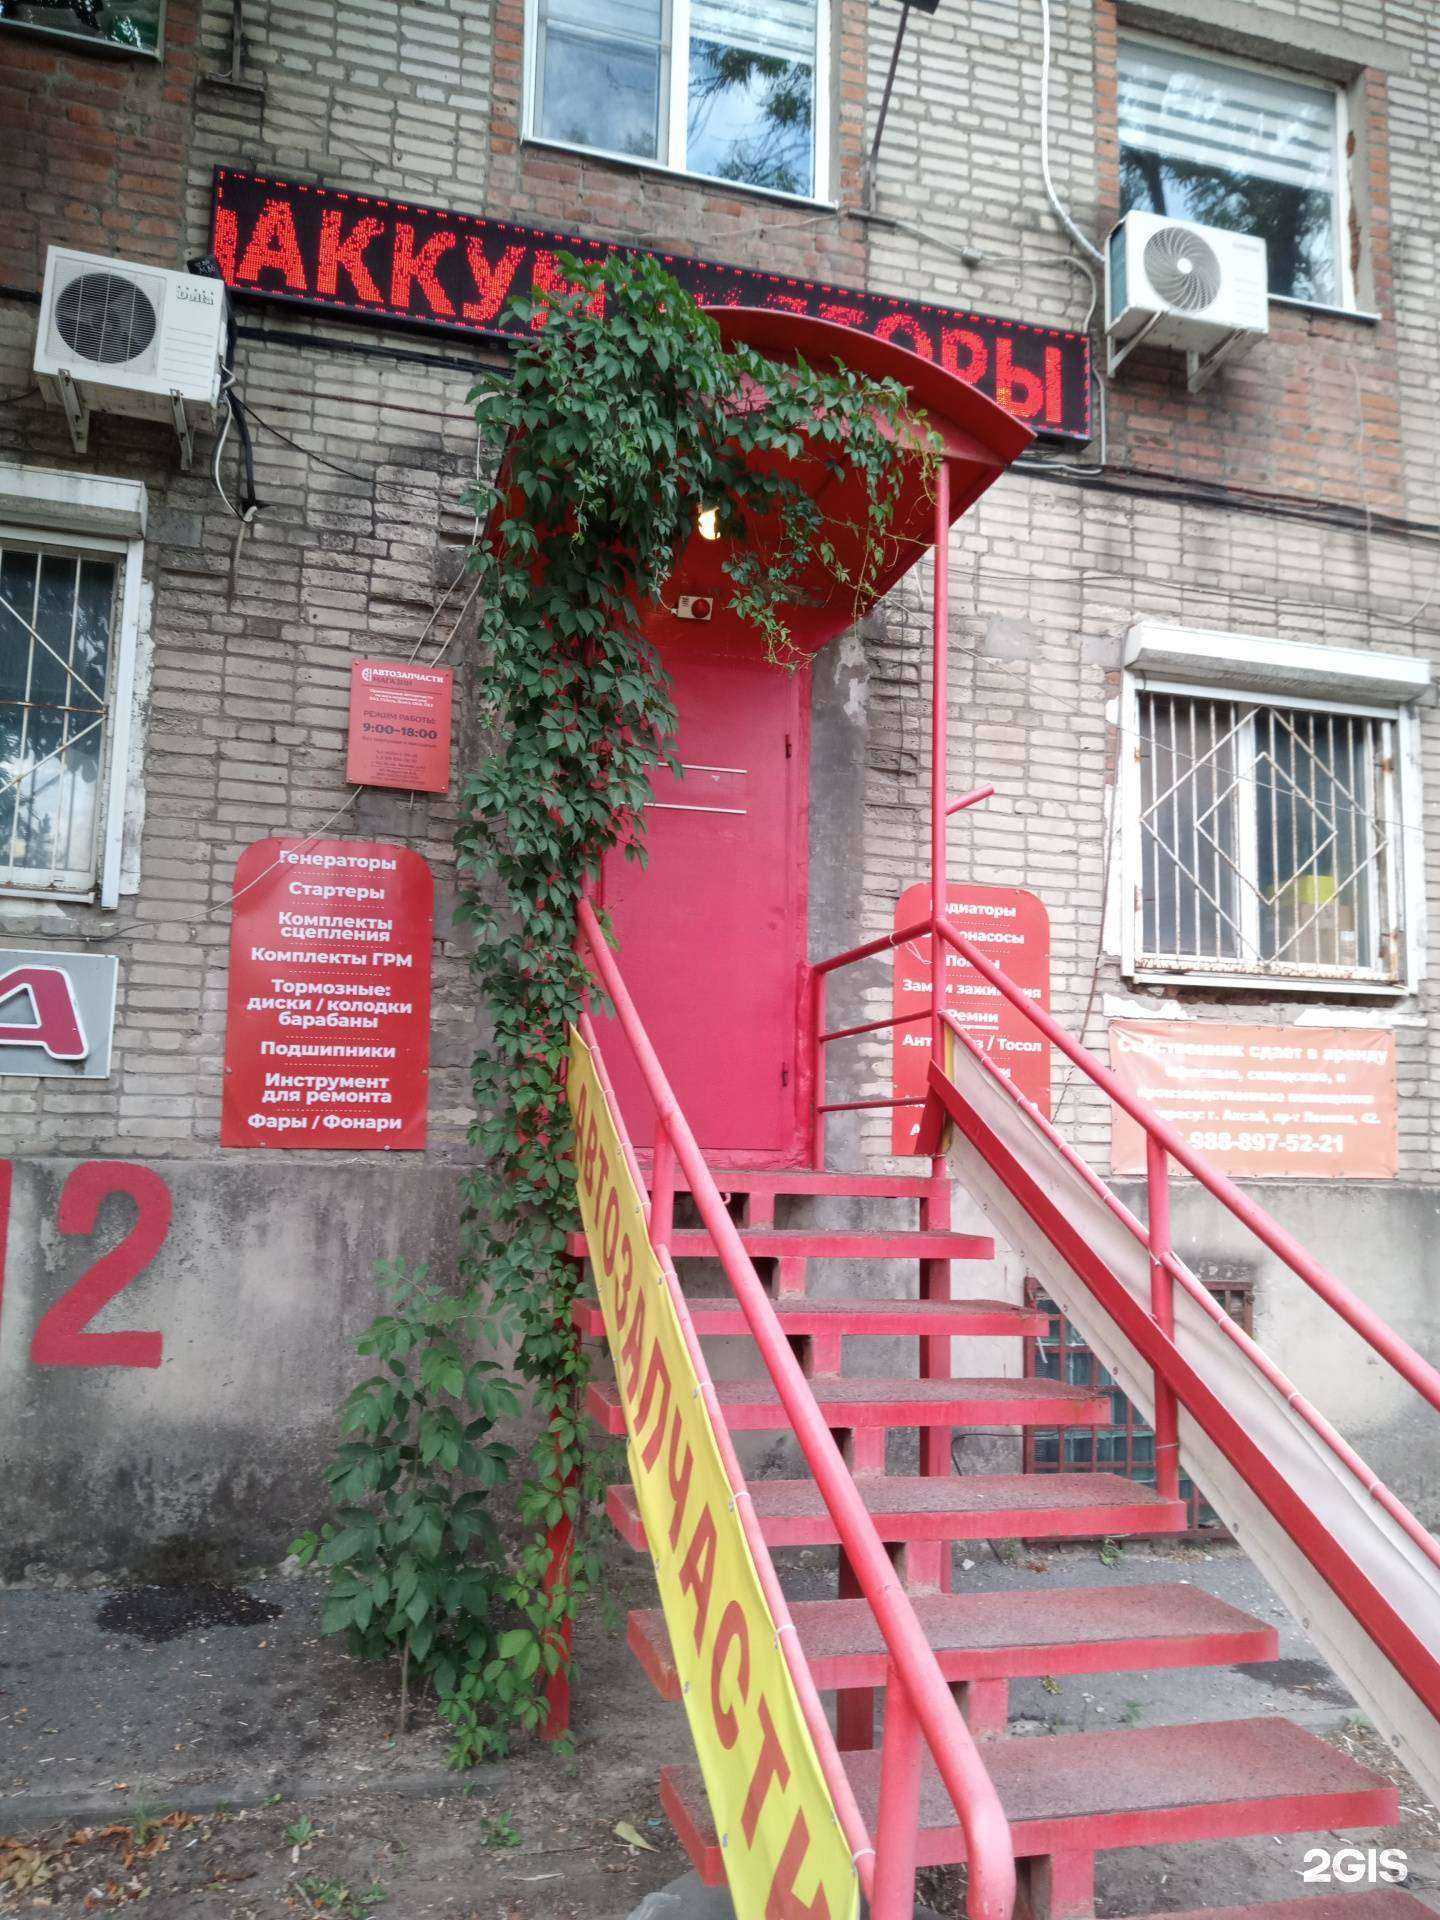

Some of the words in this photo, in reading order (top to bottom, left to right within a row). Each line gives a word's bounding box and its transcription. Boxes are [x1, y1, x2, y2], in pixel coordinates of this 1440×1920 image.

[373, 669, 443, 683] АВТОЗАПЧАСТИ
[279, 850, 397, 871] Генераторы
[288, 882, 385, 901] Стартеры
[930, 901, 1016, 917] диаторы
[278, 912, 393, 930] Комплекты
[280, 926, 391, 942] сцепления
[251, 947, 367, 965] Комплекты
[372, 952, 412, 967] ГРМ
[271, 979, 391, 997] Тормозные:
[247, 998, 311, 1011] диски
[316, 998, 324, 1012] /
[327, 1001, 412, 1014] колодки
[278, 1011, 378, 1029] барабаны
[946, 1008, 999, 1023] Ремни
[261, 1041, 396, 1058] Подшипники
[998, 1038, 1041, 1052] Тосол
[265, 1072, 390, 1091] Инструмент
[262, 1090, 301, 1103] для
[306, 1091, 392, 1104] ремонта
[248, 1113, 307, 1131] Фары
[312, 1115, 320, 1129] /
[323, 1114, 402, 1132] Фонари
